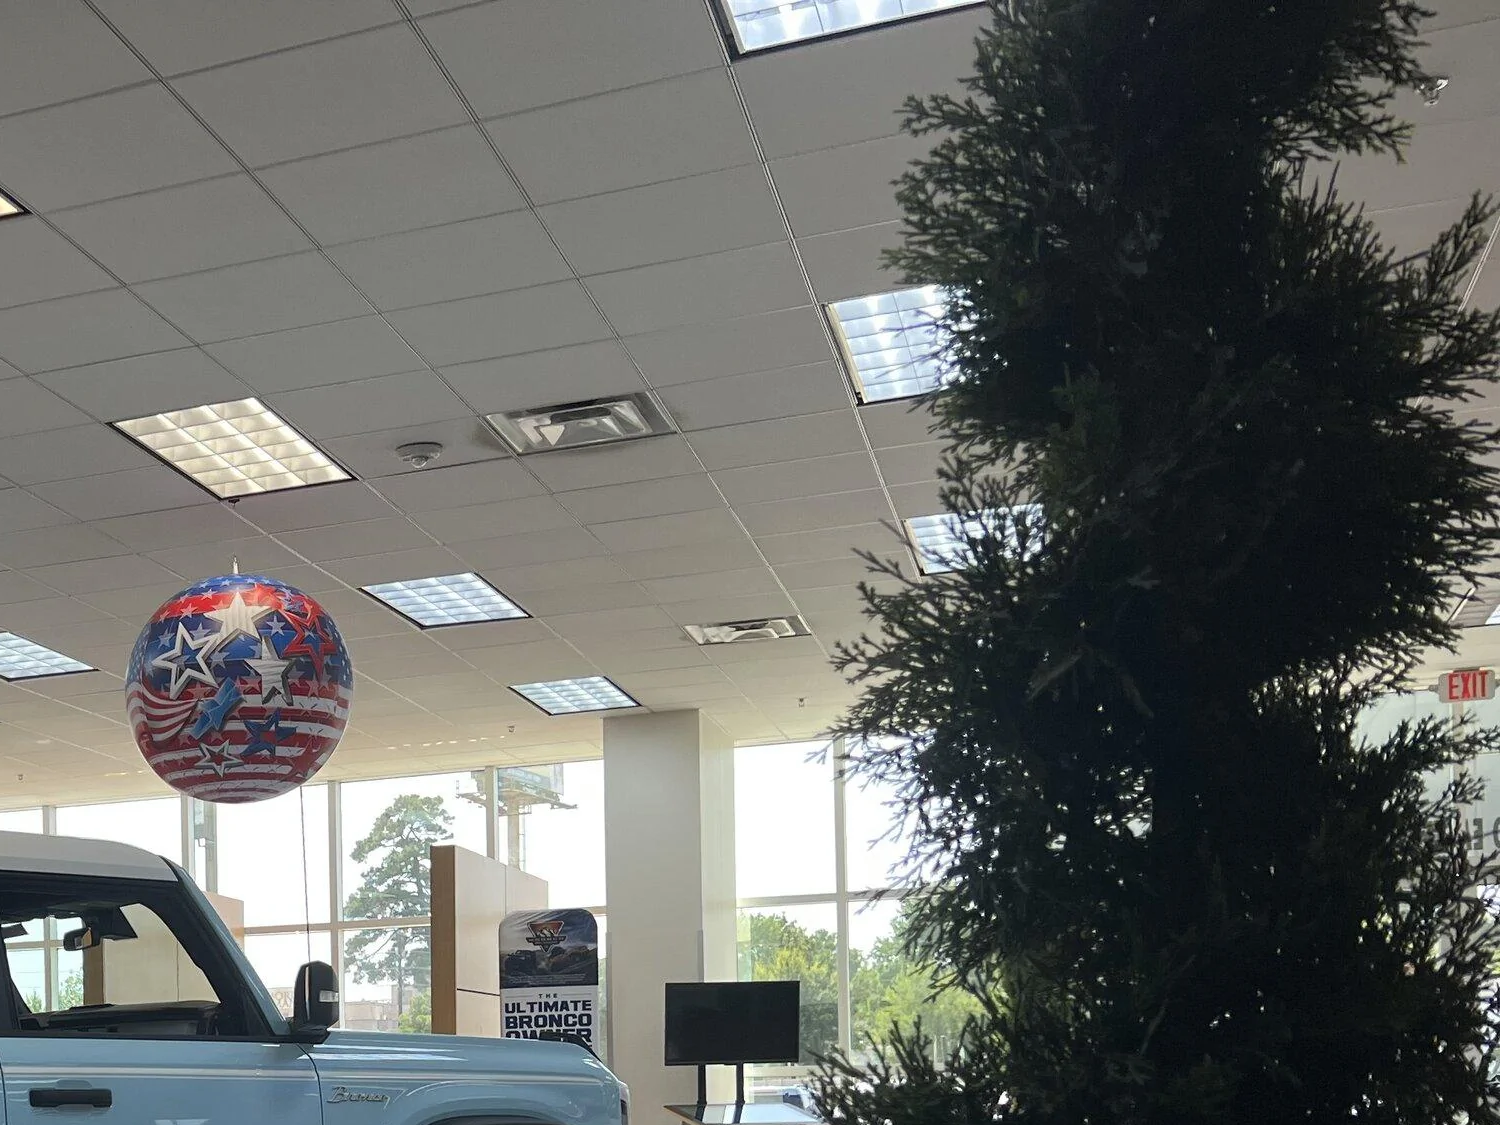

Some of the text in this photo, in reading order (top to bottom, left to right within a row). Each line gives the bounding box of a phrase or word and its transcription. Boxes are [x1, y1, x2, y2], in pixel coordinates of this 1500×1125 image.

[1448, 672, 1488, 700] EXIT
[504, 1000, 592, 1014] ULTIMATE
[505, 1013, 592, 1029] BRONCO
[505, 1028, 593, 1042] OWR
